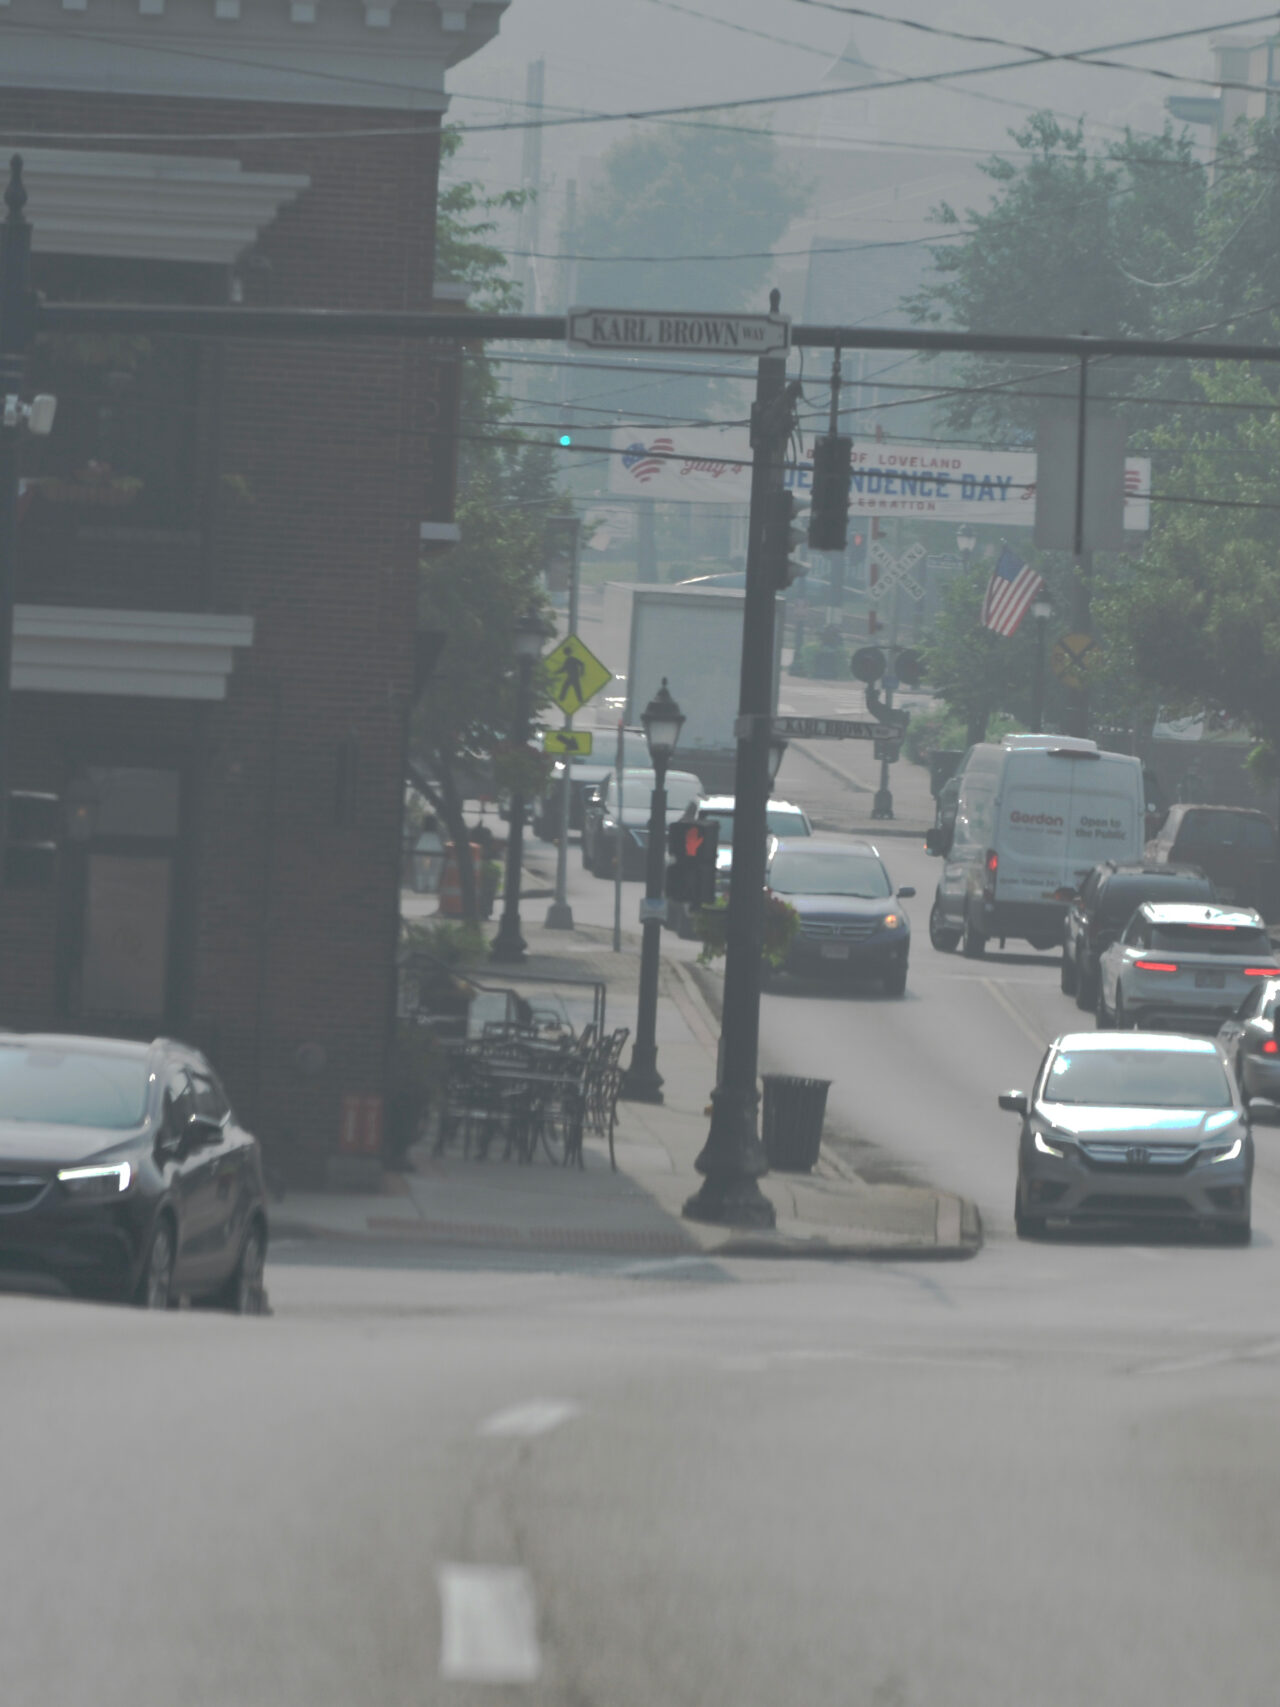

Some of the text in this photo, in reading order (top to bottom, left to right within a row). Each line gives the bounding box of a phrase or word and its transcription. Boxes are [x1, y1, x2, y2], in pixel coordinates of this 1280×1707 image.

[592, 315, 765, 346] KARL BROWN WAY
[879, 455, 962, 470] LOVELAND
[961, 473, 1013, 502] DAY
[1010, 811, 1064, 826] Gordon
[1080, 815, 1108, 829] Open
